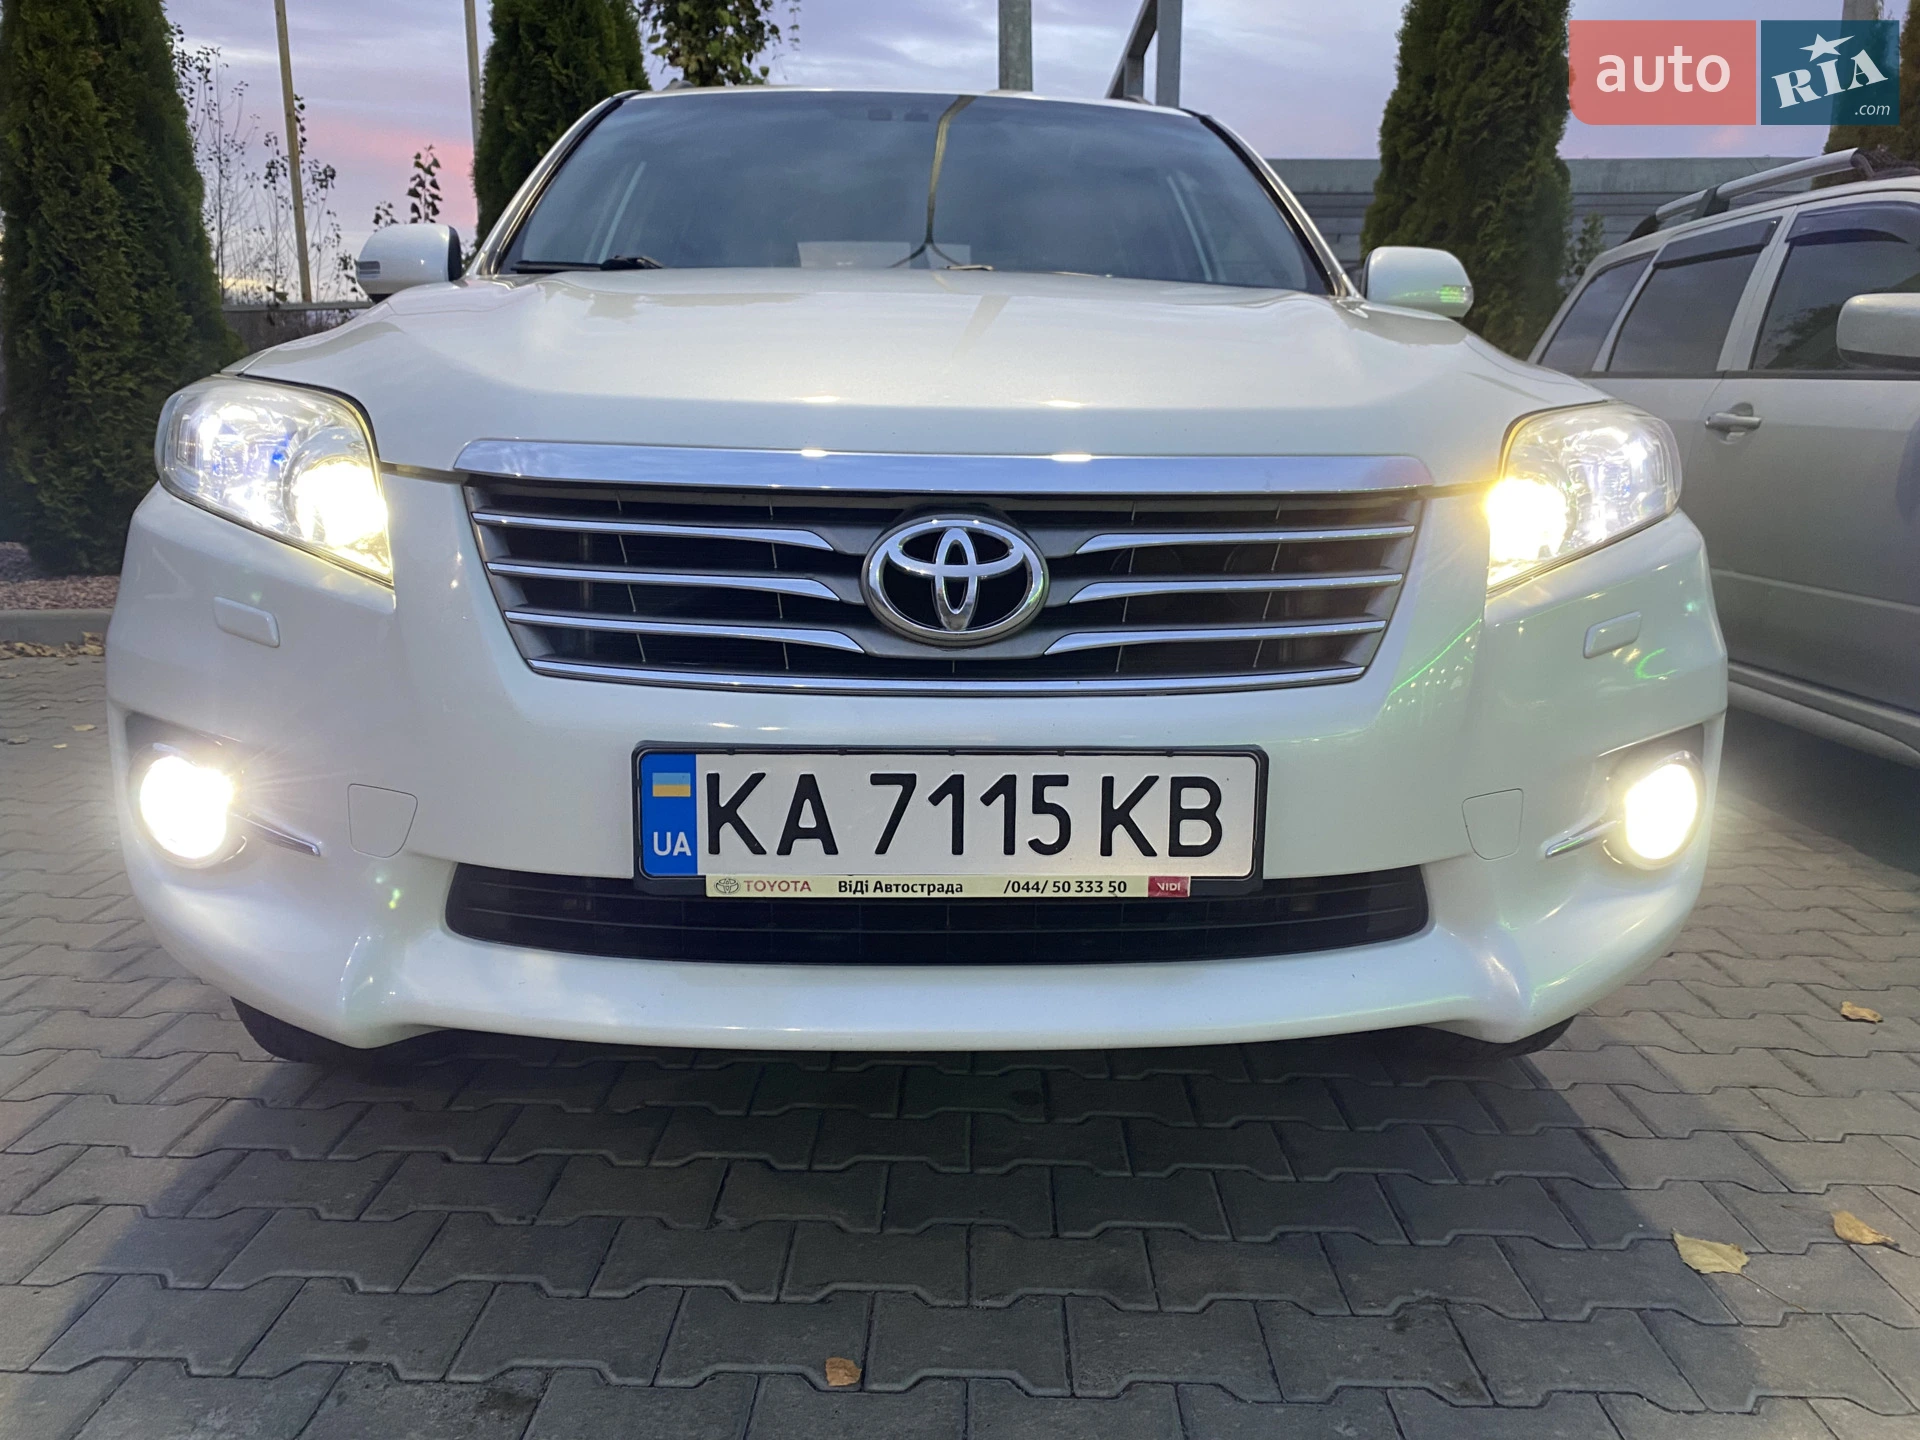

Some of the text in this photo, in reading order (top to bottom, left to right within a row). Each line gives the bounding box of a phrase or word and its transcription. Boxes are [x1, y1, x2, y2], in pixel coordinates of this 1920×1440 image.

[869, 773, 1072, 857] 7115
[653, 831, 692, 856] UA
[743, 880, 812, 893] TOYOTA
[873, 881, 964, 896] Автострада
[1003, 880, 1127, 895] /044/ 50 333 50
